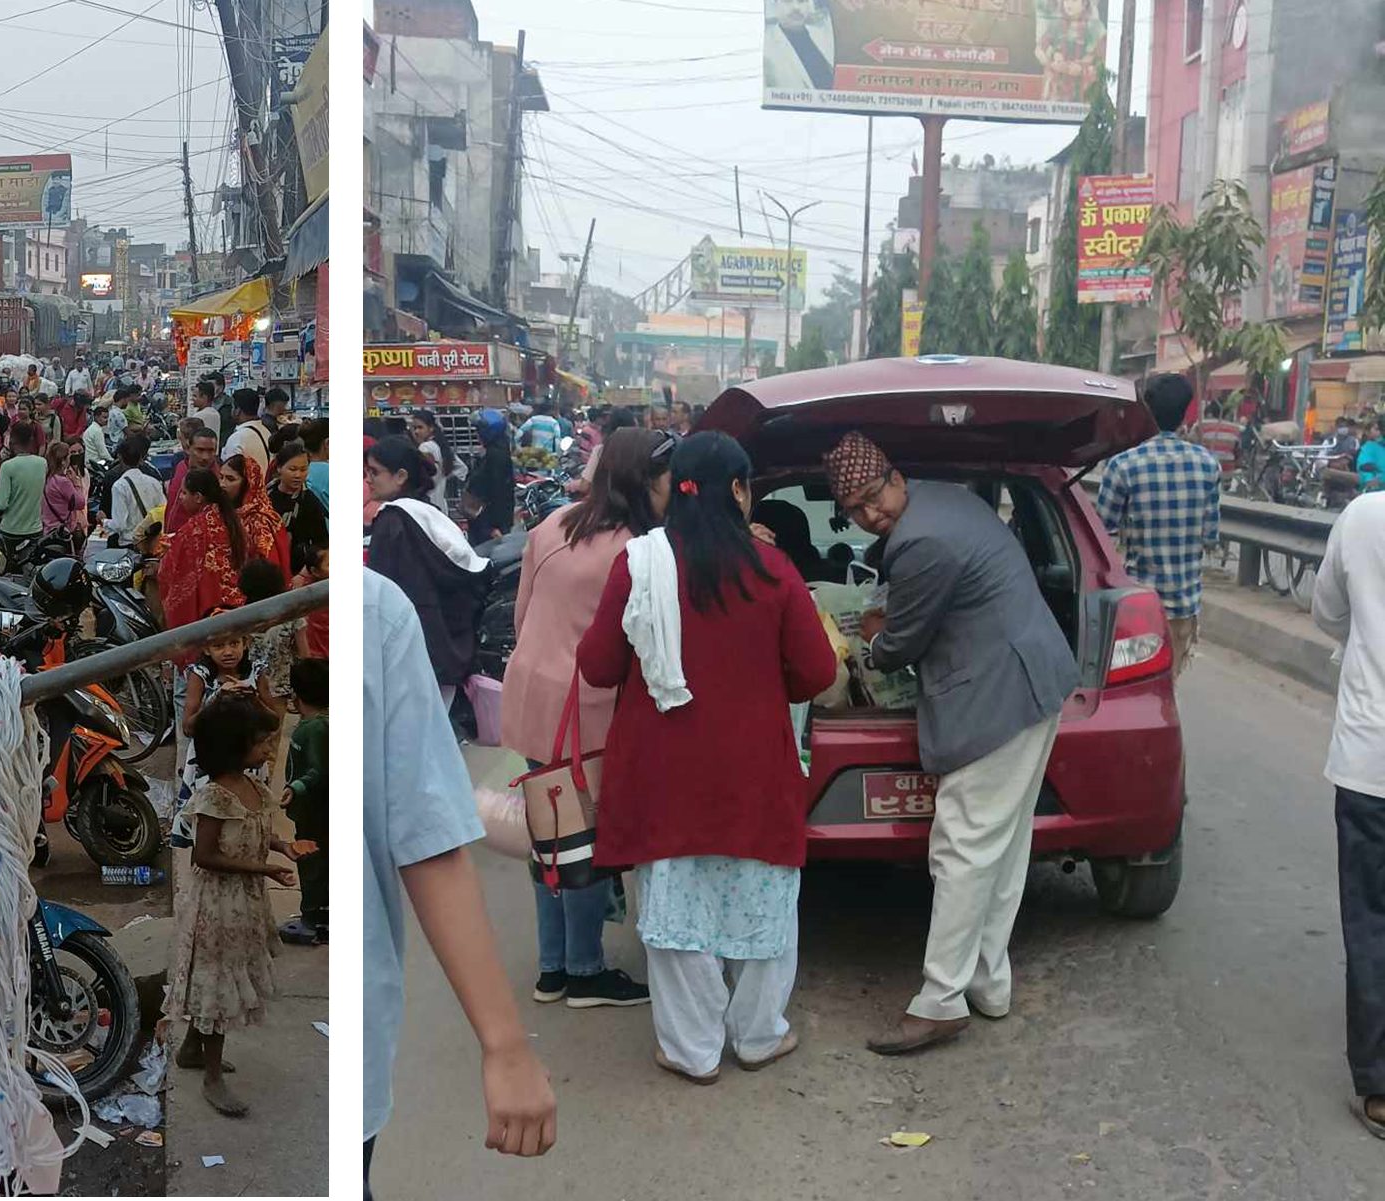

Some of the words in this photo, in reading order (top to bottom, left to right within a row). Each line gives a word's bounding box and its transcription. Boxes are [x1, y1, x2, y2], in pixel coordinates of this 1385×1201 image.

[720, 254, 765, 271] AGARWAL
[767, 257, 803, 272] PALCE
[416, 349, 440, 368] पानी
[441, 348, 459, 372] पुरी
[460, 347, 485, 367] सेन्टर
[34, 920, 53, 962] YAMAHA
